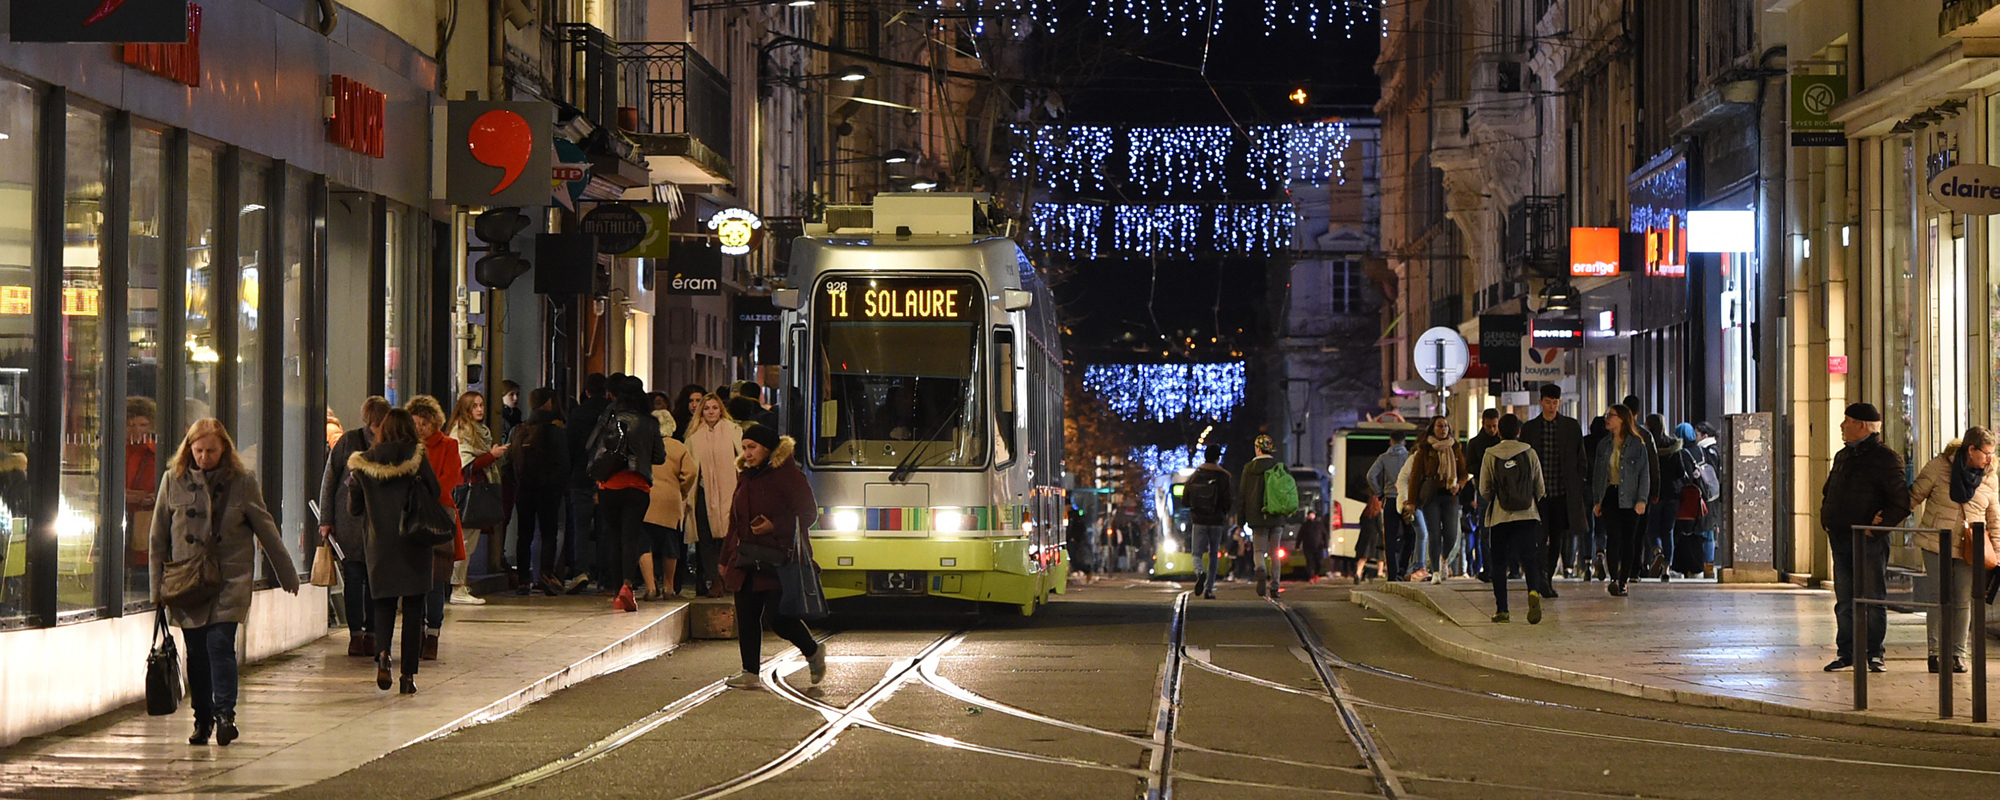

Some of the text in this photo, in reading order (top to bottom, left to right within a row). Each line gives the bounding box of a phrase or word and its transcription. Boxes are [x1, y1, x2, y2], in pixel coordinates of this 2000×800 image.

[585, 220, 642, 234] MATHILDE
[1573, 263, 1614, 276] orange
[672, 273, 717, 290] éram
[826, 281, 848, 294] 928
[829, 289, 958, 317] T1 SOLAURE
[1525, 365, 1560, 377] bouygues
